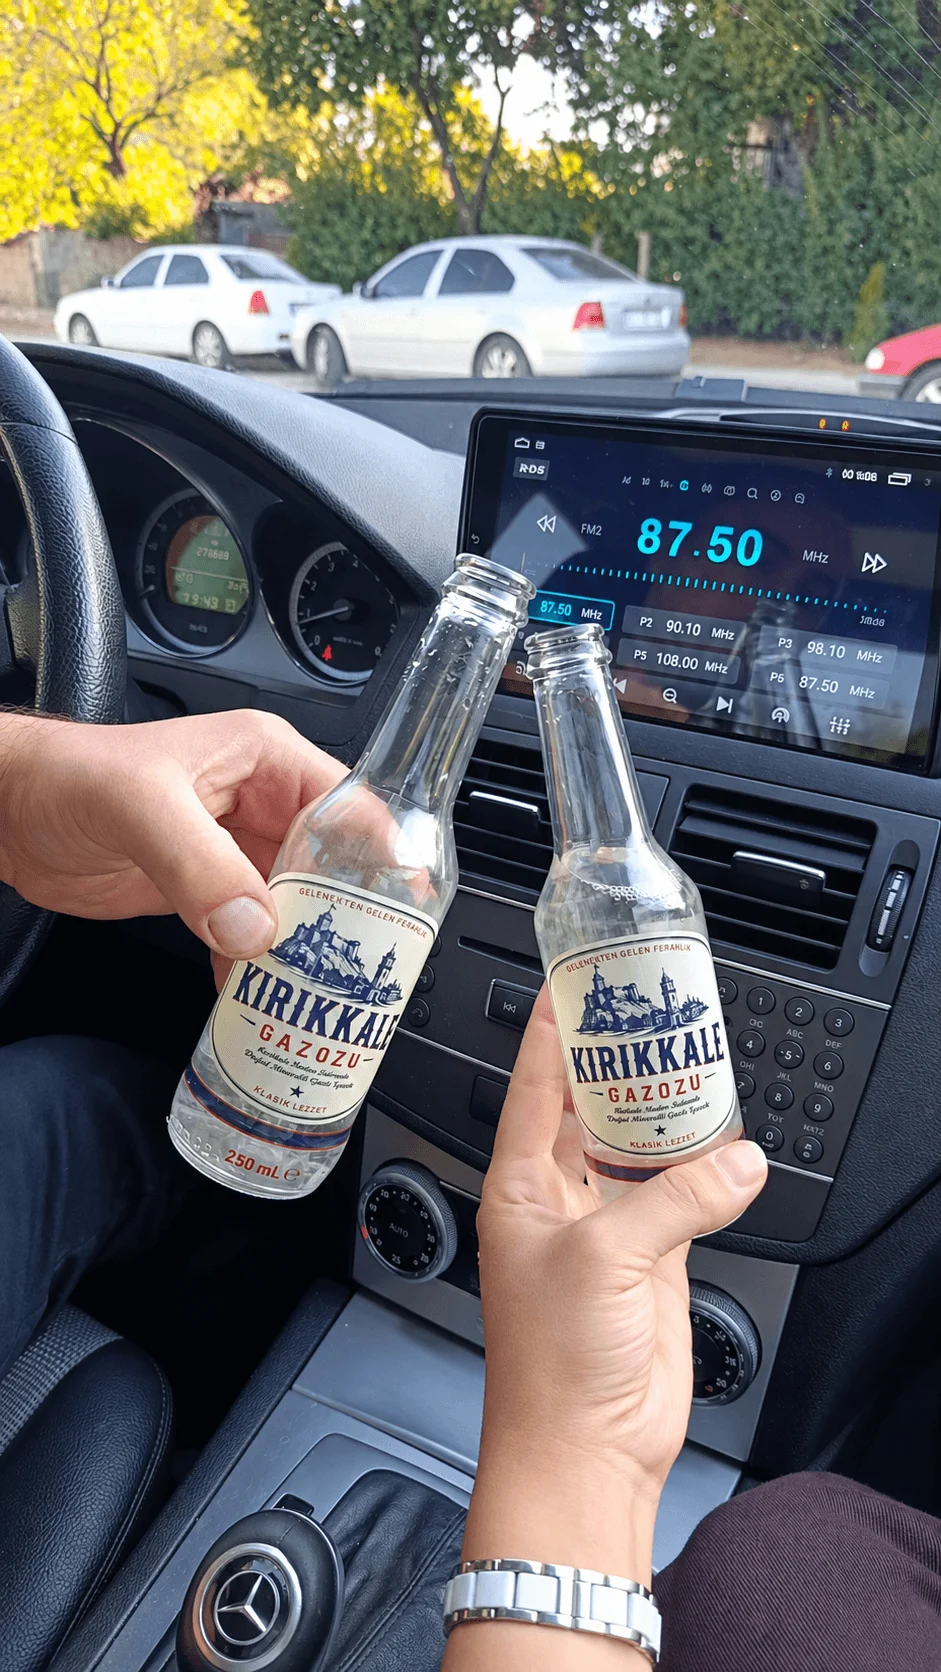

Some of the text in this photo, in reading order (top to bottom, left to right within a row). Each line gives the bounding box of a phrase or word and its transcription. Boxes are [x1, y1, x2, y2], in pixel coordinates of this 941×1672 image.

[581, 523, 602, 536] FM2
[637, 518, 829, 567] 87.50 MHz
[328, 562, 335, 572] 3
[311, 581, 317, 591] 2
[540, 601, 603, 621] 87.50 MHz
[639, 616, 735, 641] P2 90.10 MHz
[314, 635, 320, 645] 0
[778, 637, 883, 663] P3 98.10 MHz
[633, 649, 729, 675] P5 108.00 MHz
[799, 676, 839, 693] 87.50
[849, 685, 876, 699] MHz
[366, 907, 395, 923] GELEN
[620, 946, 651, 958] GELEN
[232, 961, 400, 1051] KIRIKKALE
[758, 997, 763, 1006] 1
[795, 1007, 803, 1018] 2
[834, 1018, 843, 1028] 3
[259, 1024, 361, 1069] GAZOZU
[746, 1040, 753, 1049] 4
[825, 1039, 842, 1049] DEF
[570, 1022, 725, 1084] KIRIKKALE
[784, 1050, 792, 1060] 5
[824, 1061, 832, 1071] 6
[608, 1073, 701, 1103] GAZOZU
[814, 1081, 834, 1093] MNO
[774, 1092, 782, 1102] 8
[292, 1102, 327, 1114] LEZZET
[814, 1104, 821, 1113] 9
[665, 1131, 696, 1147] LEZZET
[766, 1132, 774, 1142] 0
[224, 1149, 256, 1171] 250
[255, 1165, 279, 1180] mL
[389, 1223, 409, 1238] AUTO
